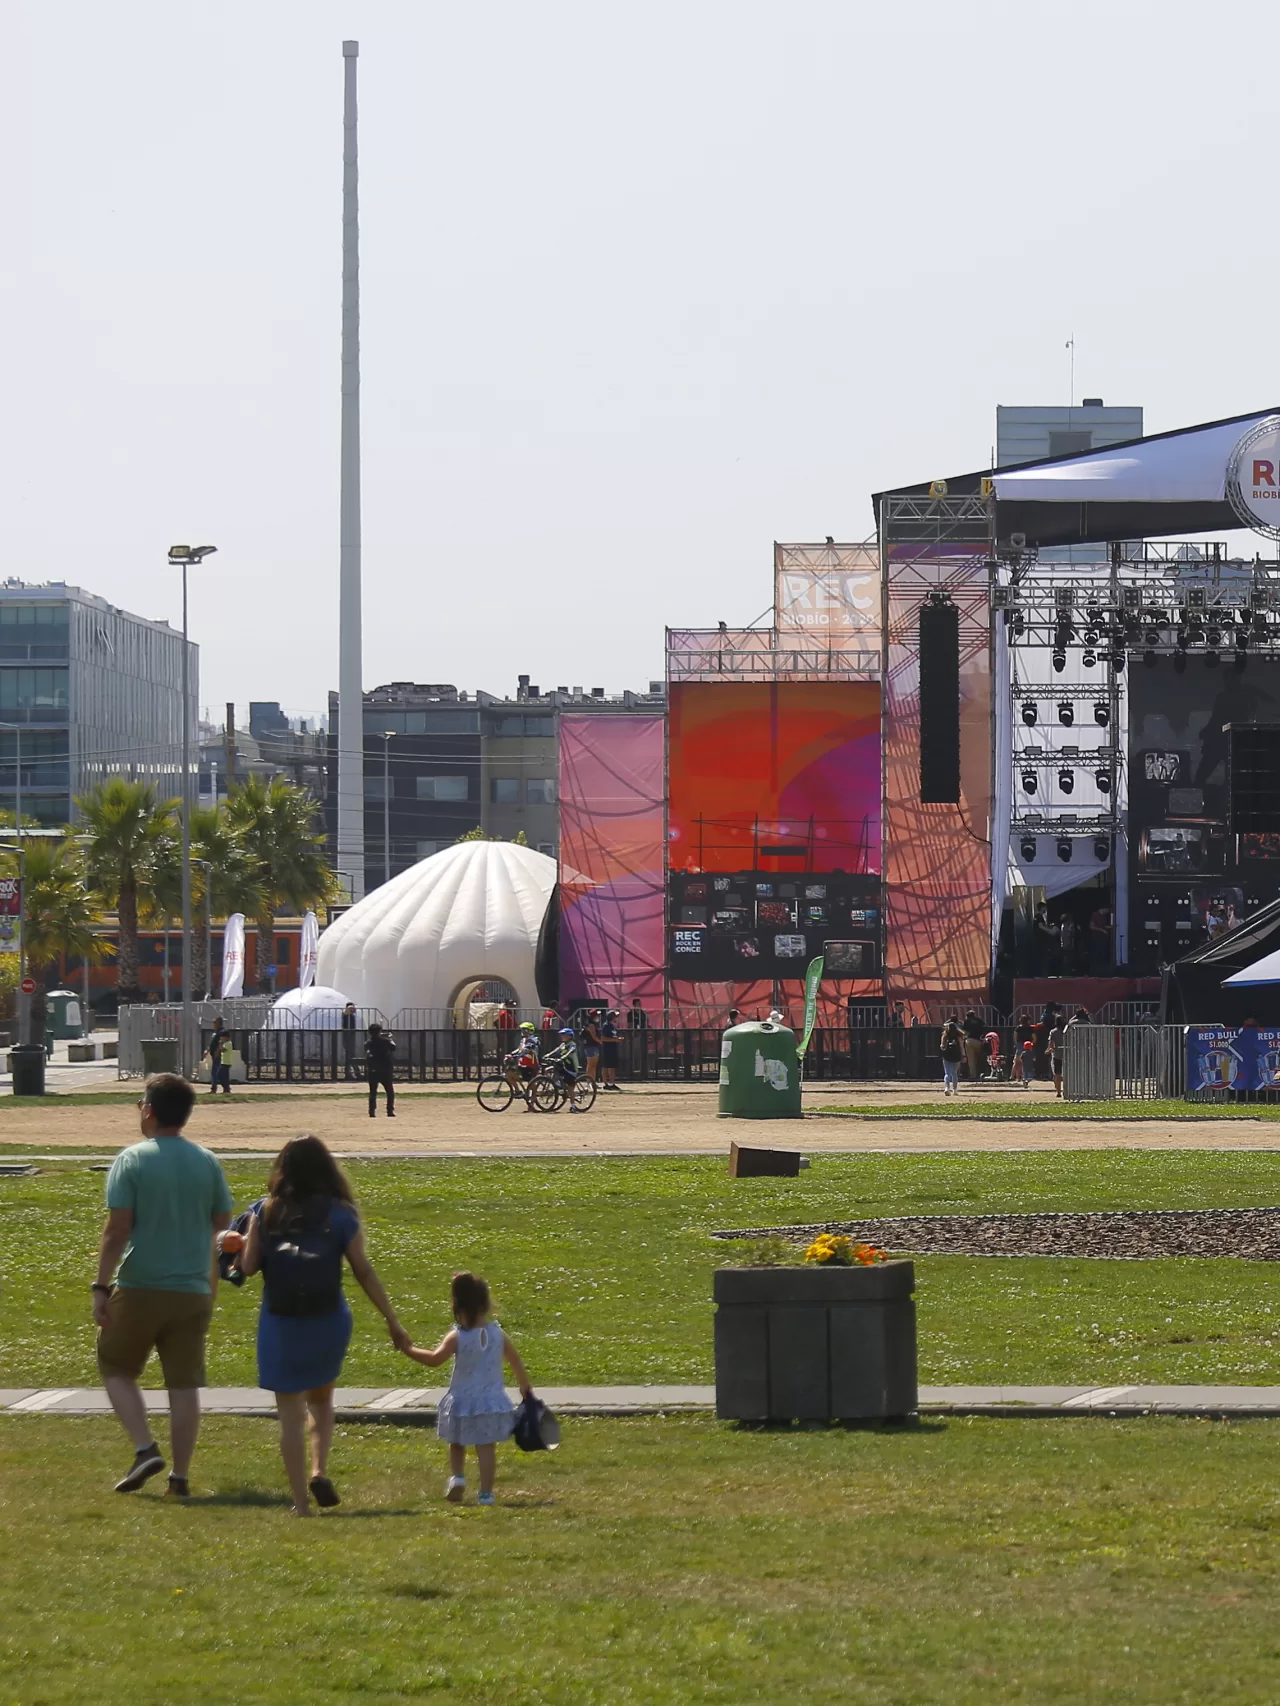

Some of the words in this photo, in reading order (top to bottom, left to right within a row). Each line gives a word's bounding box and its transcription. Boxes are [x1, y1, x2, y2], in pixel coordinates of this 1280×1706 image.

[782, 575, 874, 609] REC
[842, 614, 875, 625] 2020
[675, 931, 701, 940] REC
[1198, 1032, 1215, 1040] RED
[1217, 1031, 1238, 1039] BULL
[1257, 1032, 1274, 1040] RED
